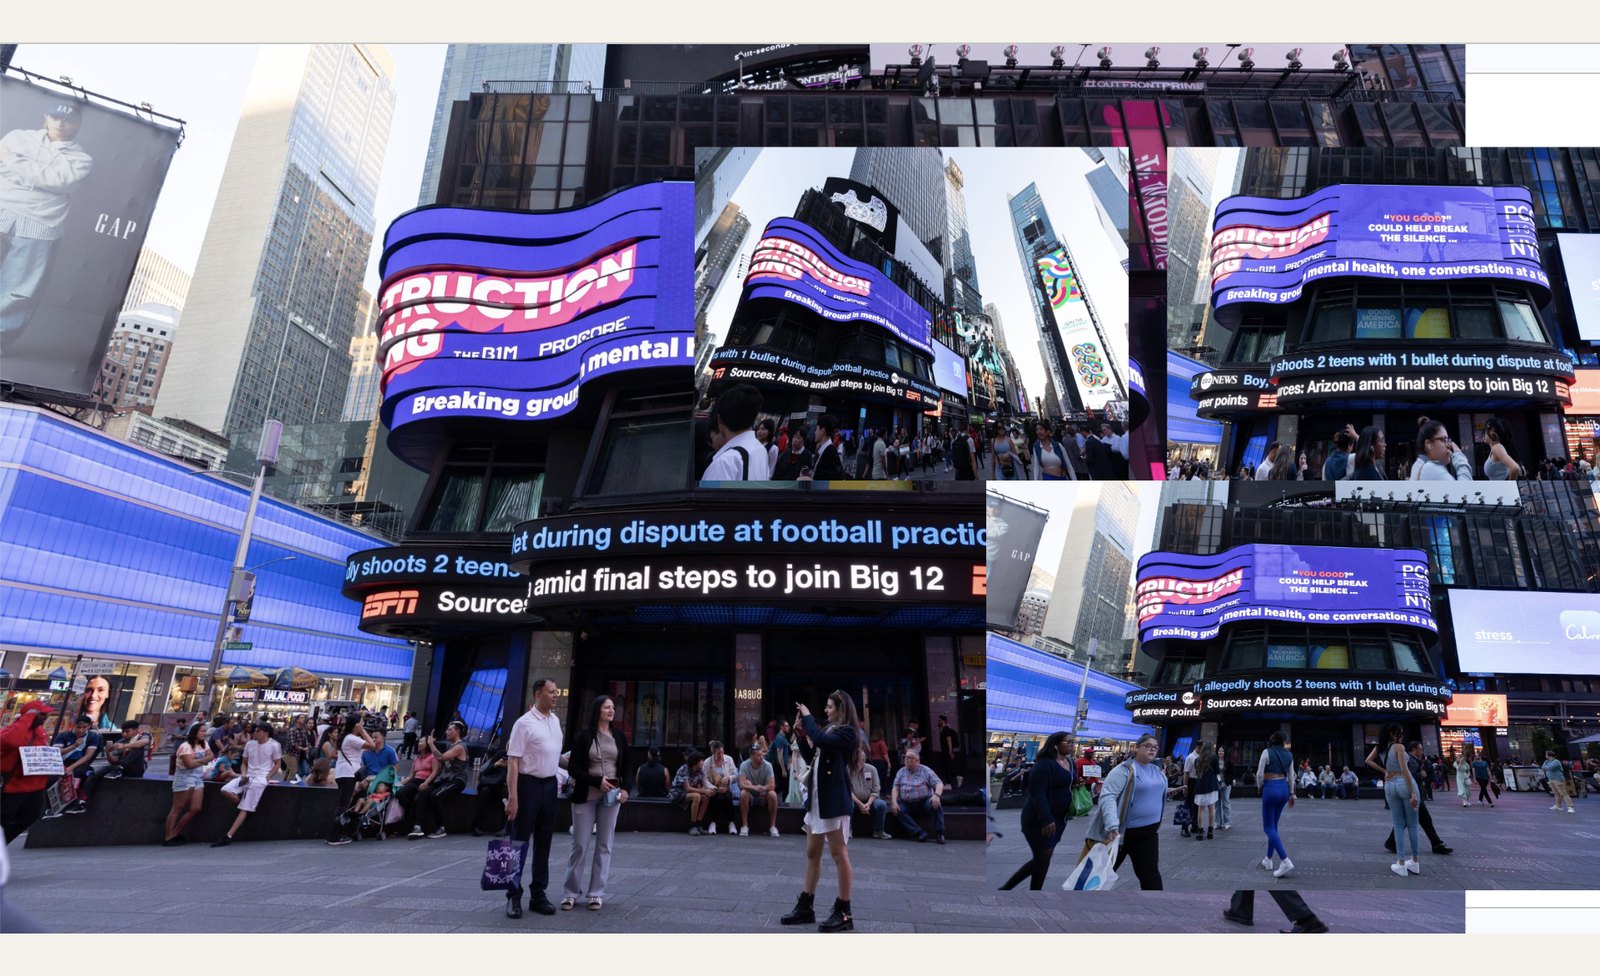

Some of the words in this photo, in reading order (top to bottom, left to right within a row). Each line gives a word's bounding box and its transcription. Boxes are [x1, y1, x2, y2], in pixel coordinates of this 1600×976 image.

[94, 213, 137, 239] GAP
[1368, 223, 1404, 232] COULD
[1405, 224, 1432, 233] HELP
[1433, 225, 1469, 233] BREAK
[1380, 233, 1401, 242] THE
[1402, 234, 1446, 243] SILENCE
[1308, 260, 1349, 278] mental
[1352, 260, 1398, 277] health,
[1401, 265, 1426, 276] one
[1429, 263, 1514, 276] conversation
[1516, 266, 1528, 277] at
[1529, 270, 1537, 280] a
[784, 290, 823, 314] Breaking
[1227, 288, 1278, 302] Breaking
[1357, 321, 1401, 329] AMERICA
[453, 350, 479, 359] THE
[588, 336, 672, 373] mental
[1276, 357, 1315, 372] shoots
[1317, 356, 1326, 368] 2
[1329, 355, 1365, 368] teens
[1368, 353, 1397, 367] with
[1400, 354, 1407, 366] 1
[1411, 353, 1449, 367] bullet
[1452, 353, 1493, 370] during
[1497, 354, 1541, 371] dispute
[1543, 357, 1555, 370] at
[720, 349, 739, 359] with
[749, 350, 780, 364] bullet
[782, 357, 806, 373] during
[863, 368, 889, 380] practice
[730, 367, 776, 381] Sources:
[777, 372, 808, 387] Arizona
[841, 379, 862, 389] steps
[864, 381, 872, 390] to
[873, 383, 885, 393] join
[886, 385, 896, 396] Big
[897, 388, 903, 396] 12
[1211, 375, 1239, 385] NEWS
[1243, 374, 1269, 389] Boy,
[1307, 378, 1356, 394] Arizona
[1359, 376, 1393, 391] amid
[1396, 377, 1425, 391] final
[1428, 378, 1466, 394] steps
[1469, 378, 1483, 391] to
[1485, 376, 1510, 394] join
[1512, 378, 1534, 395] Big
[1535, 379, 1549, 393] 12
[412, 390, 520, 416] Breaking
[1214, 394, 1248, 409] points
[532, 523, 612, 551] during
[620, 519, 726, 549] dispute
[734, 519, 764, 543] at
[769, 518, 883, 544] football
[1011, 549, 1031, 562] GAP
[361, 554, 428, 576] shoots
[433, 553, 449, 574] 2
[533, 568, 587, 597] amid
[593, 565, 650, 592] final
[658, 565, 738, 594] steps
[746, 564, 777, 588] to
[784, 563, 841, 594] join
[850, 564, 900, 596] Big
[909, 565, 945, 591] 12
[1279, 577, 1310, 586] COULD
[1312, 578, 1336, 587] HELP
[1337, 579, 1368, 588] BREAK
[1289, 585, 1309, 594] THE
[1309, 586, 1349, 595] SILENCE
[361, 589, 420, 620] ESPN
[1224, 607, 1261, 621] mental
[1264, 607, 1306, 621] health,
[1308, 612, 1330, 621] one
[1332, 610, 1408, 622] conversation
[1409, 614, 1420, 624] at
[1421, 617, 1428, 625] a
[1153, 627, 1198, 639] Breaking
[1474, 629, 1513, 641] stress
[263, 689, 287, 702] HALAL
[287, 691, 306, 703] FOOD
[1204, 679, 1251, 692] allegedly
[1253, 679, 1292, 689] shoots
[1295, 679, 1302, 689] 2
[1305, 680, 1337, 690] teens
[1340, 680, 1363, 690] with
[1366, 681, 1372, 690] 1
[1376, 681, 1406, 692] bullet
[1408, 682, 1438, 696] during
[1133, 692, 1177, 702] carjacked
[1207, 698, 1252, 709] Sources:
[1253, 696, 1298, 707] Arizona
[1301, 696, 1330, 707] amid
[1332, 696, 1357, 708] final
[1359, 697, 1390, 710] steps
[1392, 698, 1404, 709] to
[1405, 698, 1424, 712] join
[1425, 701, 1438, 713] Big
[1142, 708, 1169, 717] career
